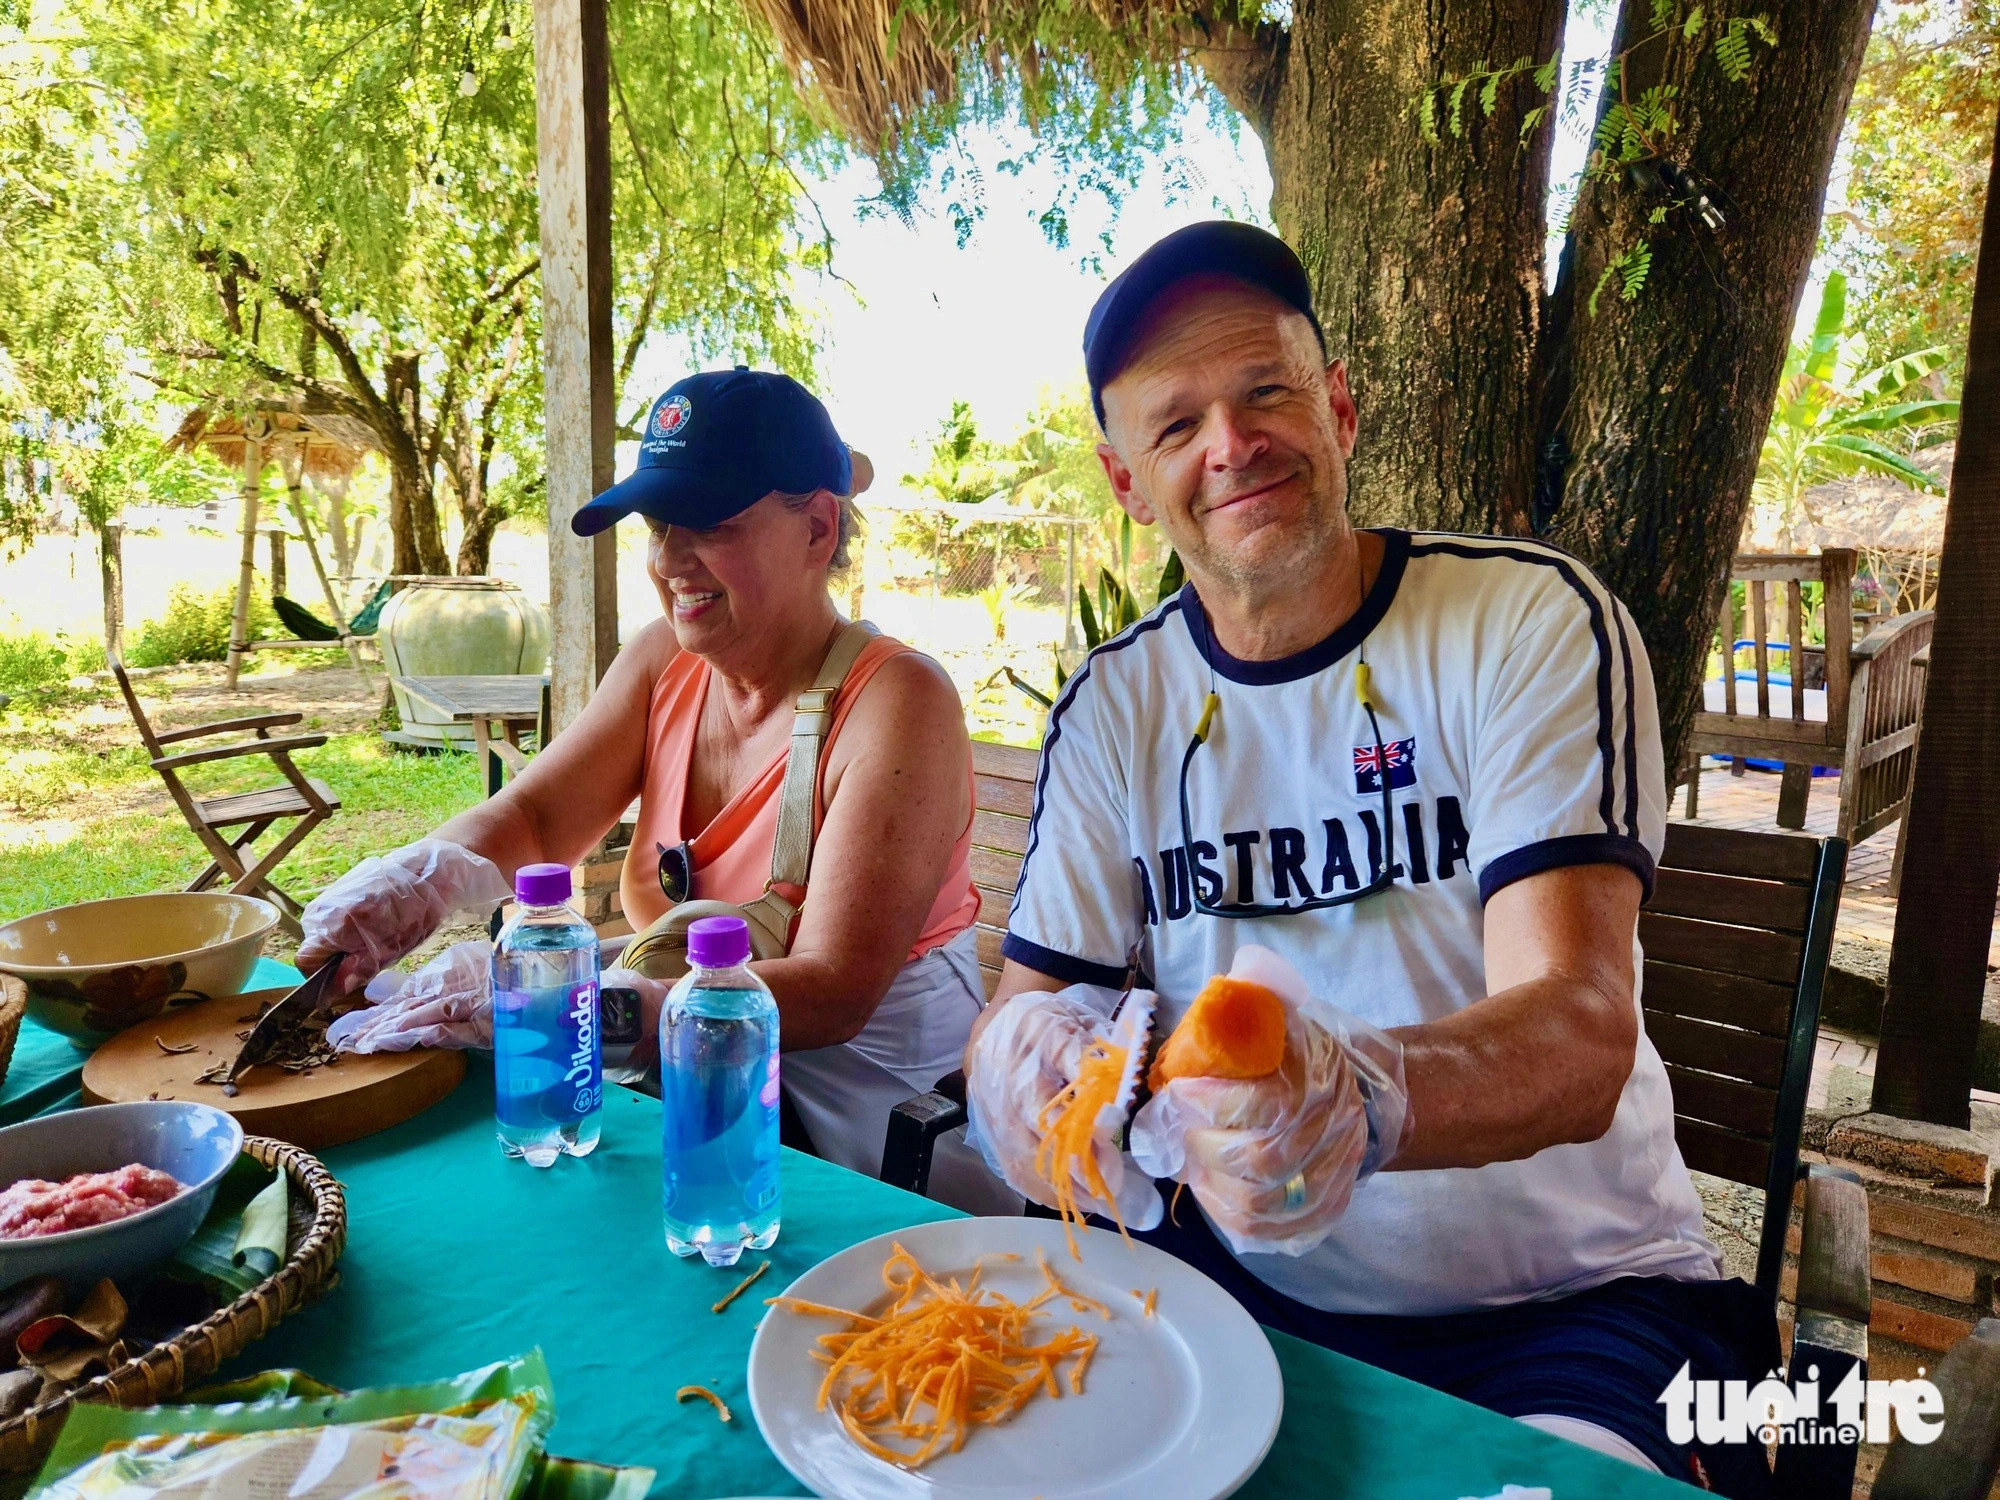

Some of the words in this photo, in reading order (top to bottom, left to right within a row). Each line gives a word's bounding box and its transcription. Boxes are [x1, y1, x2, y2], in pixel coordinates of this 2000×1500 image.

[649, 446, 669, 454] Insignia
[1133, 796, 1472, 926] AUSTRALIA
[563, 985, 593, 1088] Vikoda
